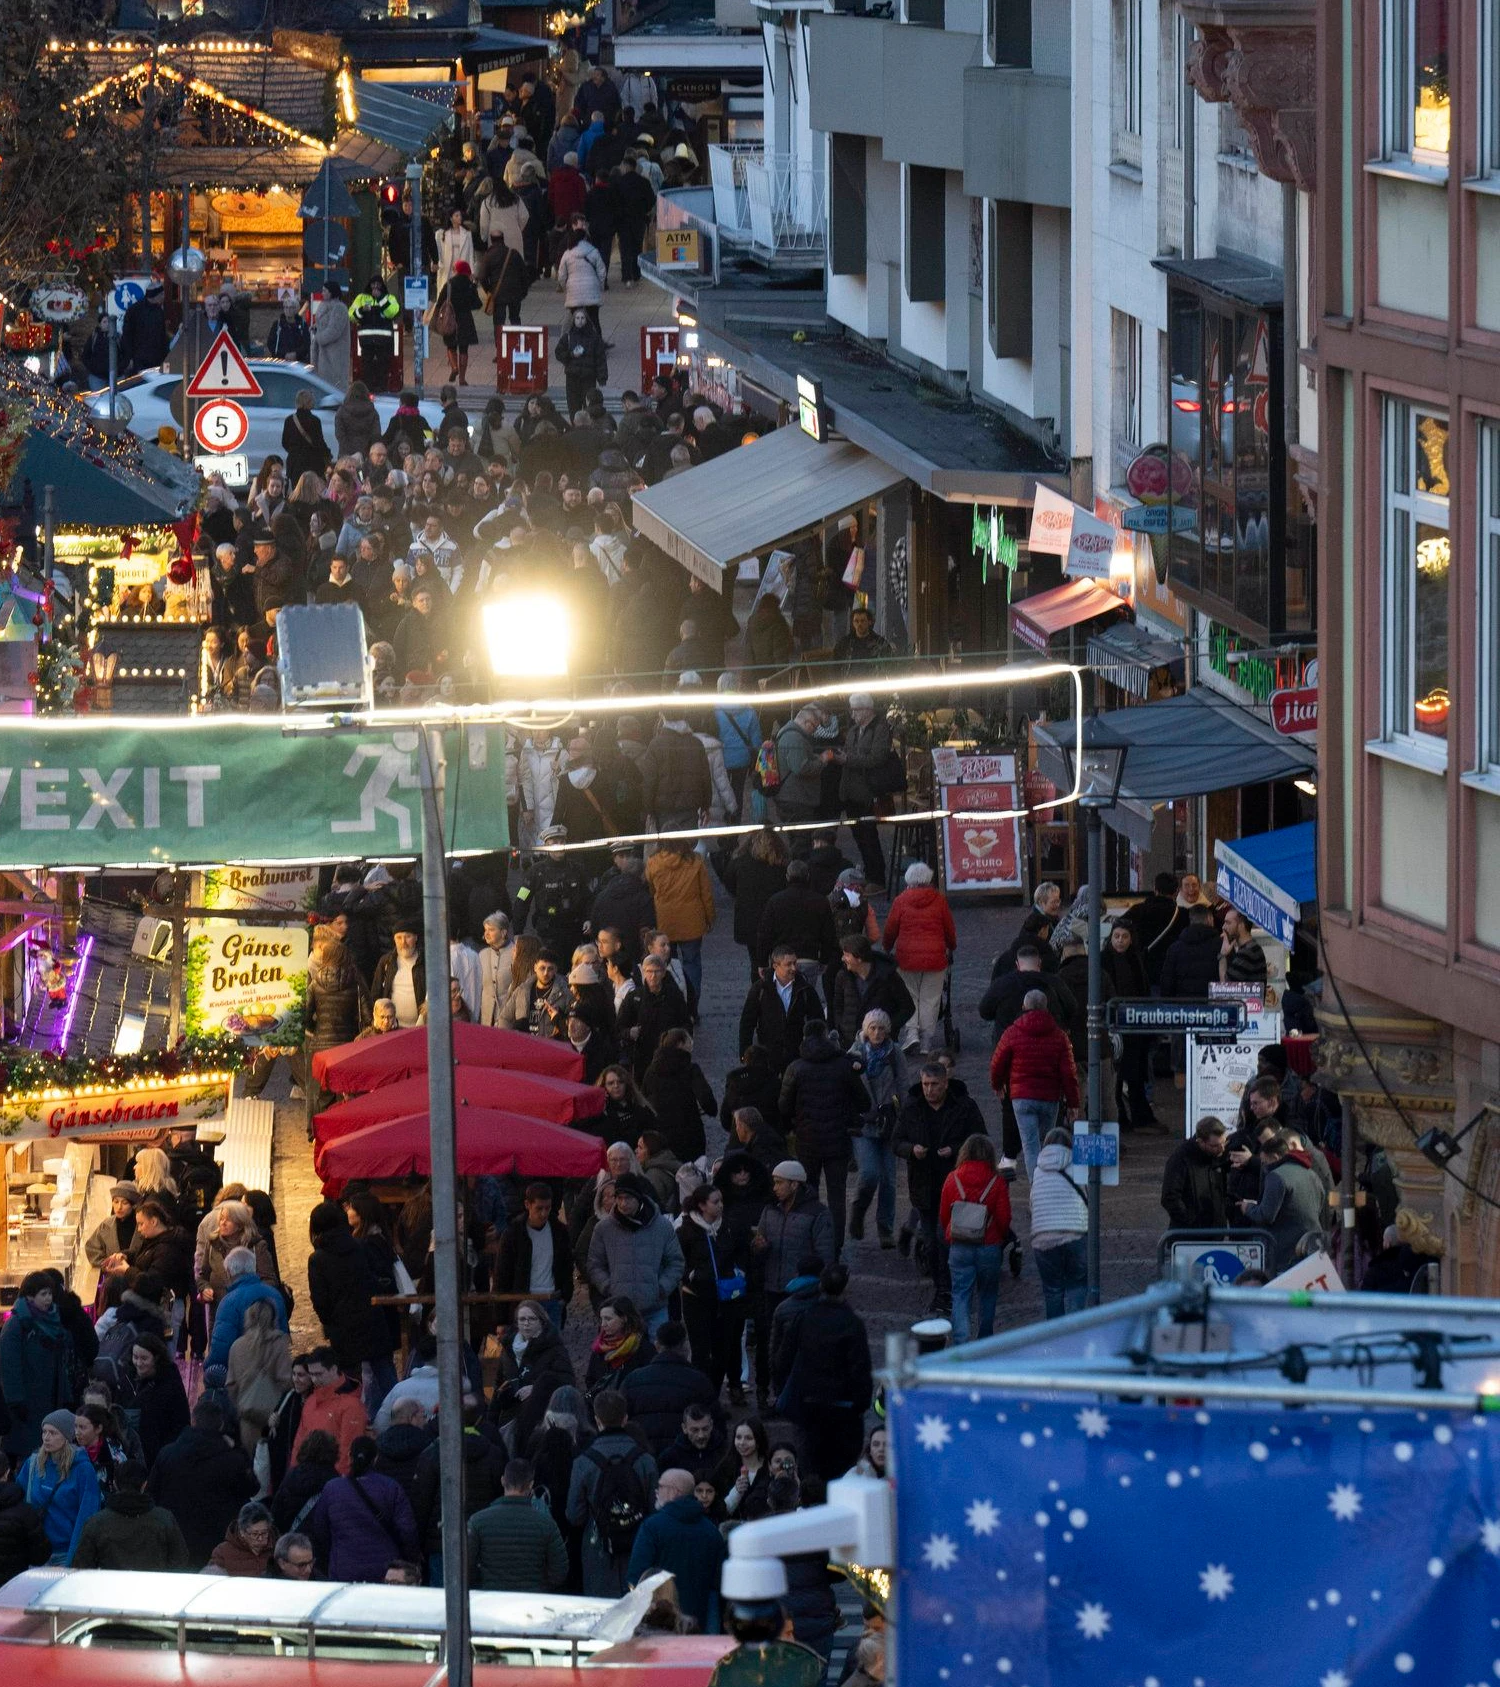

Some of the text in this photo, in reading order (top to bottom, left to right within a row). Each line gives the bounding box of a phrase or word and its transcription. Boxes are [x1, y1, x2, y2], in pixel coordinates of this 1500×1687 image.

[666, 232, 691, 243] ATM
[215, 416, 229, 438] 5
[230, 866, 314, 888] Bratwurst
[222, 934, 293, 966] Gänse
[212, 963, 284, 992] Braten
[238, 996, 254, 1006] und
[1126, 1008, 1229, 1026] Braubachstraße
[1217, 1046, 1252, 1054] TO GO
[48, 1097, 180, 1138] Gänsebraten
